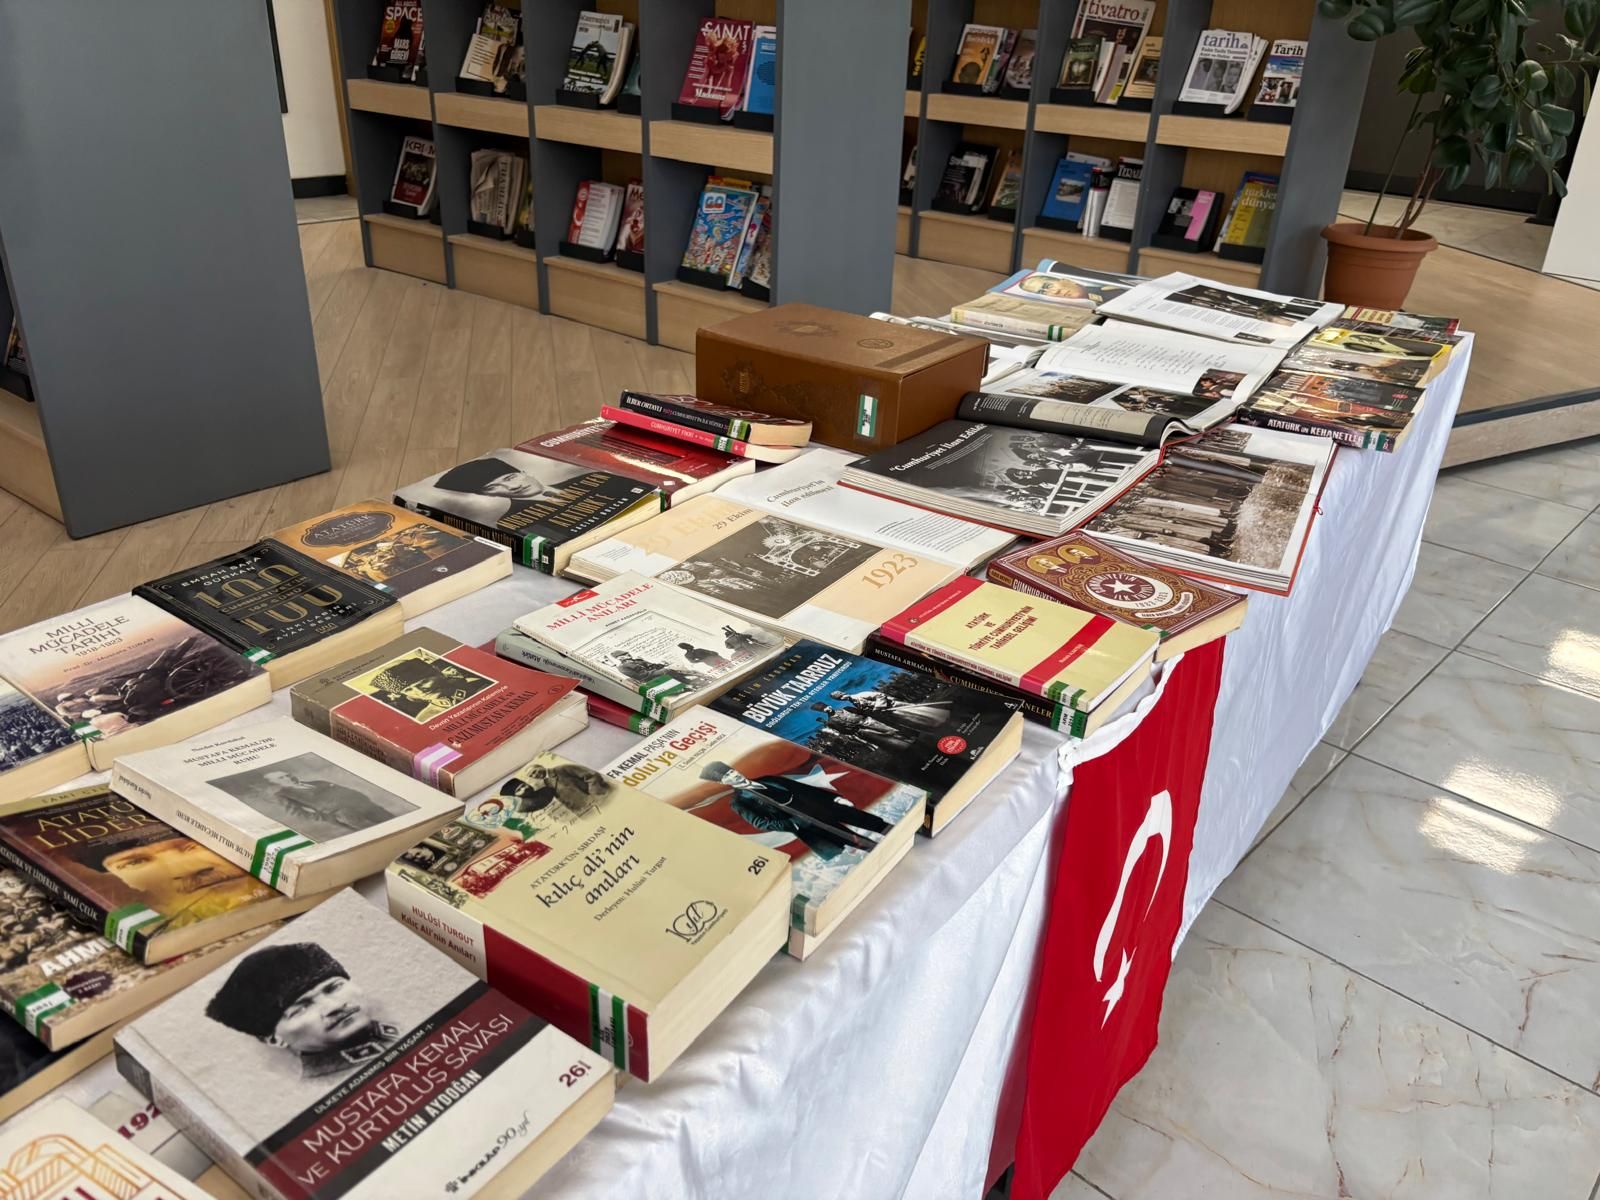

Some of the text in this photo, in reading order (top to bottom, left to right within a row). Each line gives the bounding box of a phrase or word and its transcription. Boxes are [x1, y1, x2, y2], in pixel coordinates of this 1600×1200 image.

[385, 6, 423, 22] SPACE
[701, 21, 751, 42] SANAT
[1203, 32, 1240, 49] tarih
[1274, 44, 1304, 56] Tarih
[496, 503, 558, 531] MUSTAFA
[712, 507, 755, 531] 29 Ekim
[180, 568, 227, 587] EMRAH
[861, 551, 919, 590] 1923
[546, 606, 588, 632] MİLLİ
[587, 599, 638, 624] ANILARI
[29, 615, 130, 655] MÜCADELE
[874, 648, 1001, 696] MUSTAFA ARMAĞAN CUMHURİYE
[741, 653, 844, 724] BÜYÜK TAARRUZ
[618, 751, 649, 774] KEMAL
[623, 720, 718, 788] dolu'ya Geçişi
[33, 814, 162, 849] LİDER
[38, 800, 136, 832] ATATÜ
[535, 825, 635, 909] kılıç ali'nin
[585, 854, 640, 905] anıları
[594, 895, 626, 921] Derleyen:
[644, 855, 667, 877] Turgut
[442, 922, 474, 946] TURGUT
[448, 940, 477, 962] Anıları
[298, 1013, 514, 1187] VE KURTULUŞ SAVAŞI
[303, 1020, 481, 1154] MUSTAFA KEMAL
[381, 1069, 482, 1152] METİN AYDOĞAN
